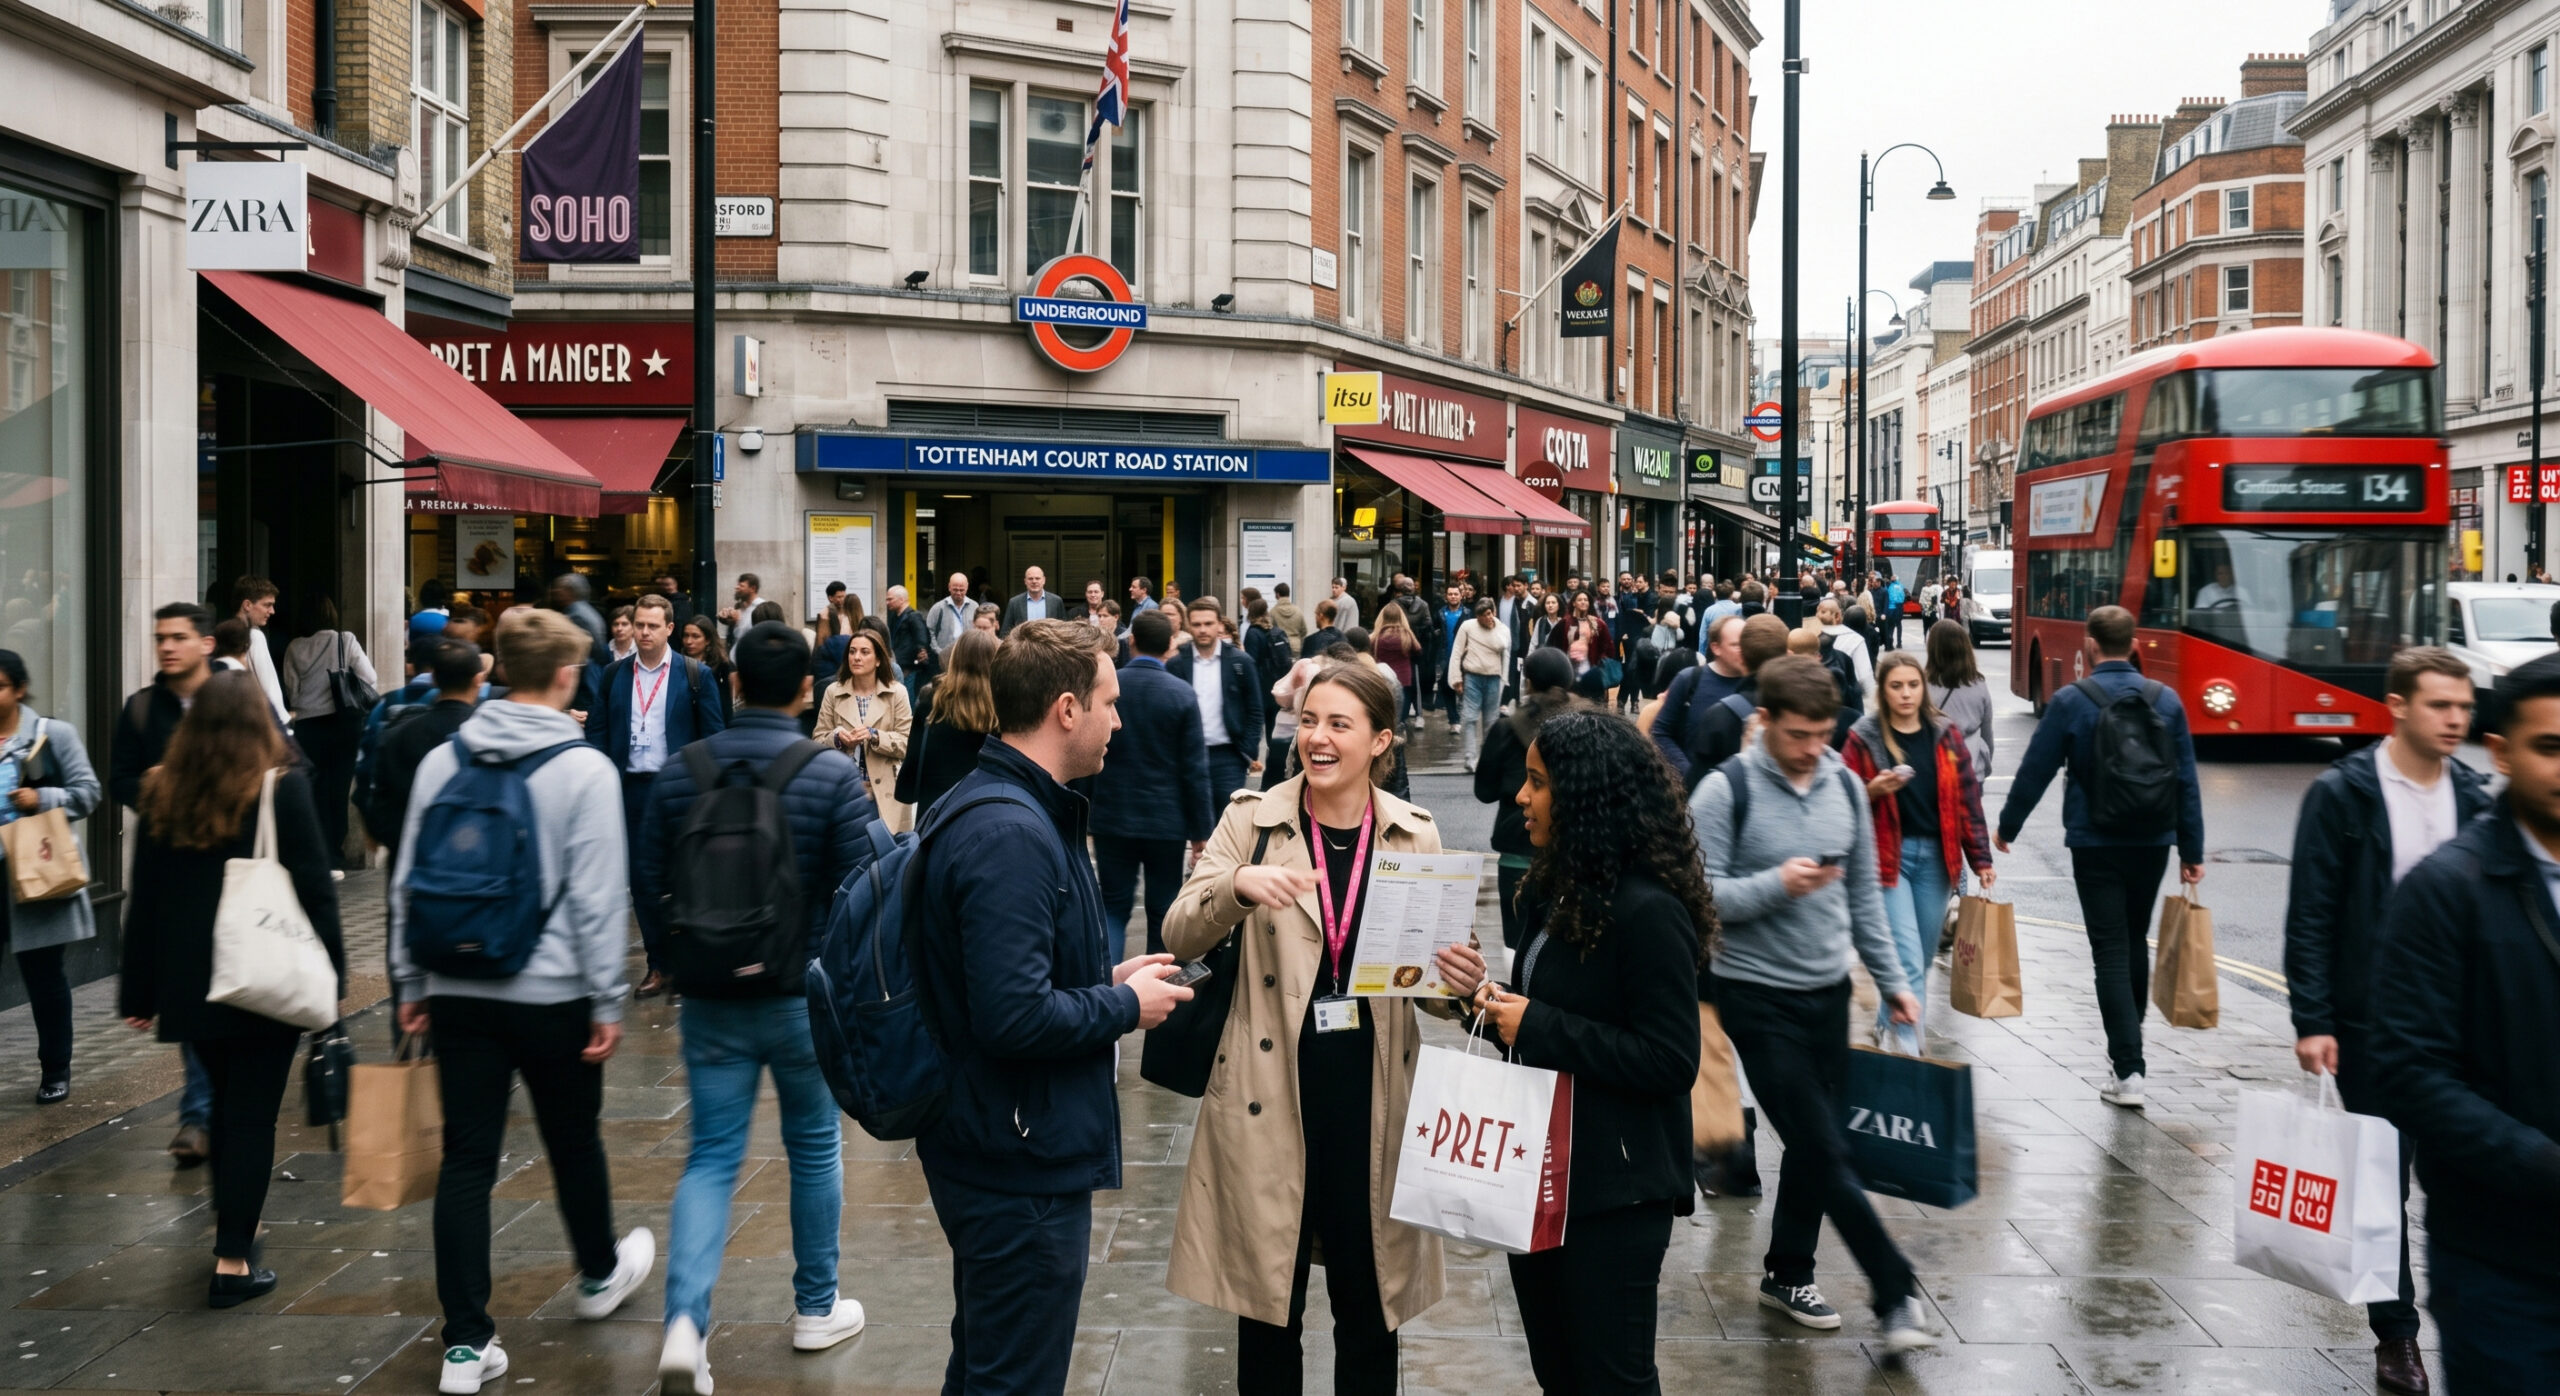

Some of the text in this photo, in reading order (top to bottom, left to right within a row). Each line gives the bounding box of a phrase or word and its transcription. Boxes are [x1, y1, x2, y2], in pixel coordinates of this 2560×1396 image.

[191, 199, 297, 233] ZARA
[529, 194, 630, 243] SOHO
[715, 204, 765, 216] SFORD
[1024, 303, 1141, 322] UNDERGROUND
[500, 342, 517, 382] A
[527, 343, 632, 382] MANGER
[1333, 388, 1372, 407] itsu
[1393, 390, 1465, 441] PRET A MANGER
[916, 446, 1248, 472] TOTTENHAM COURT ROAD STATION
[1546, 427, 1589, 472] COSTA
[1525, 477, 1559, 488] COSTA
[2363, 474, 2409, 502] 134
[2541, 469, 2560, 483] UN
[1378, 859, 1400, 872] itsu
[1431, 1107, 1515, 1173] PRET
[1847, 1106, 1938, 1149] ZARA
[2298, 1177, 2330, 1204] UNI
[2294, 1199, 2328, 1224] QLO
